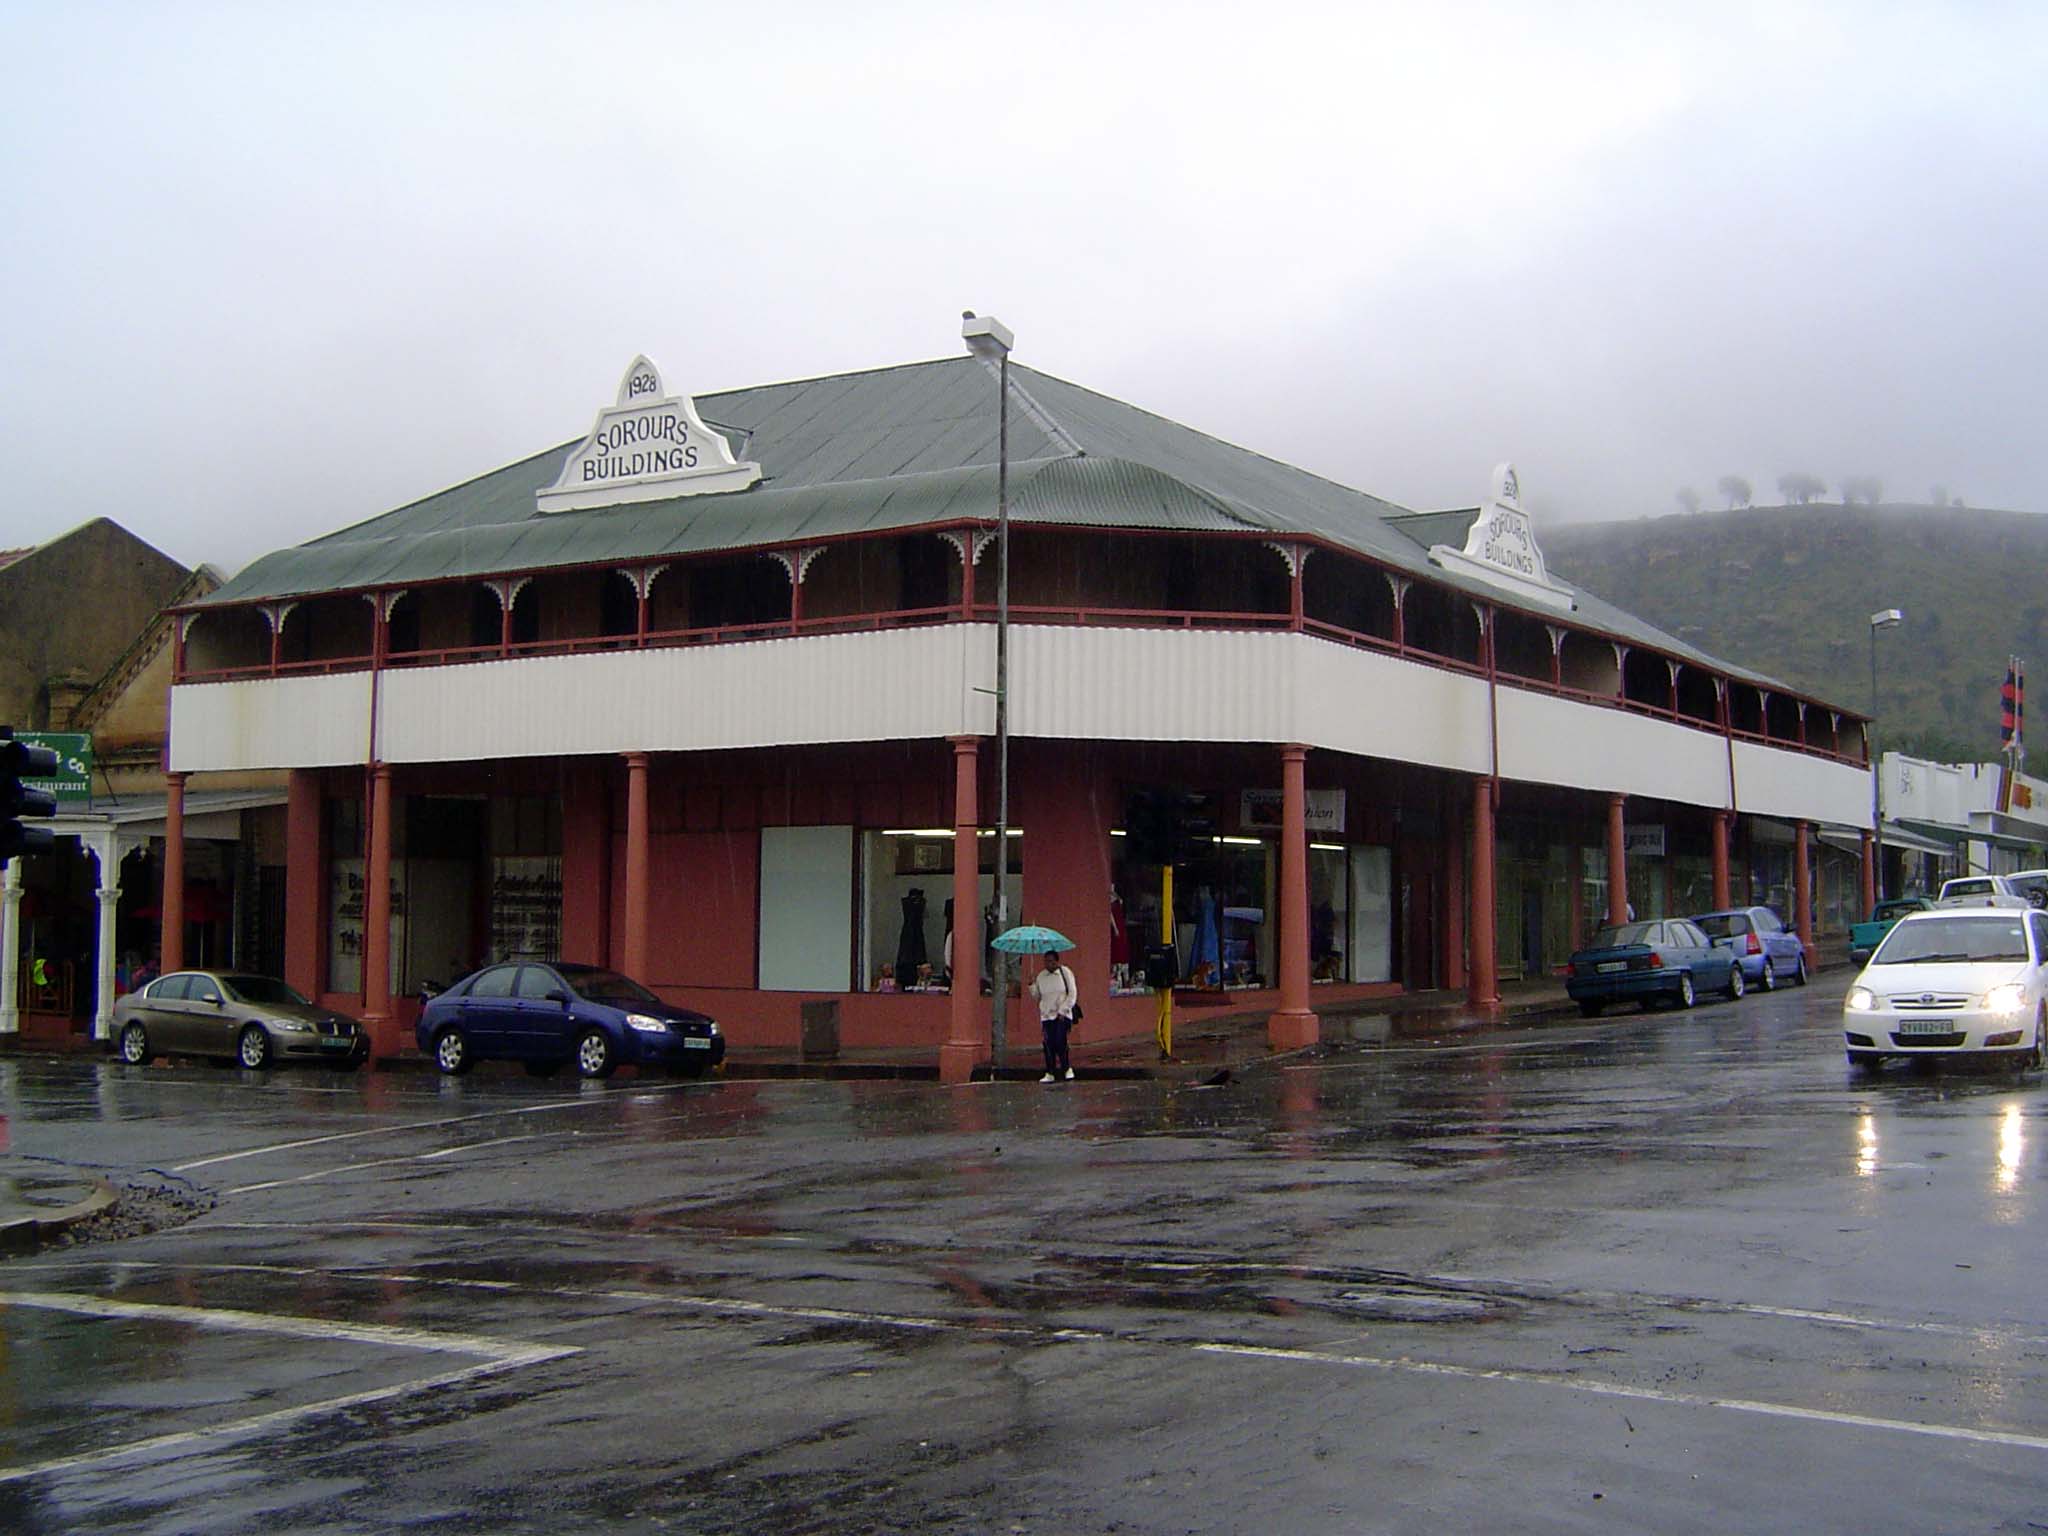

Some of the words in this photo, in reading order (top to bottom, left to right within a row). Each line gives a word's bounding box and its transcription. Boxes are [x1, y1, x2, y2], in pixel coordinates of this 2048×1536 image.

[628, 374, 657, 399] 1928
[597, 415, 688, 457] SOROURS
[583, 446, 697, 481] BUILDINGS
[1489, 513, 1527, 551] SOROURS
[1485, 541, 1533, 575] BUILDINGS
[19, 779, 86, 791] estaurant
